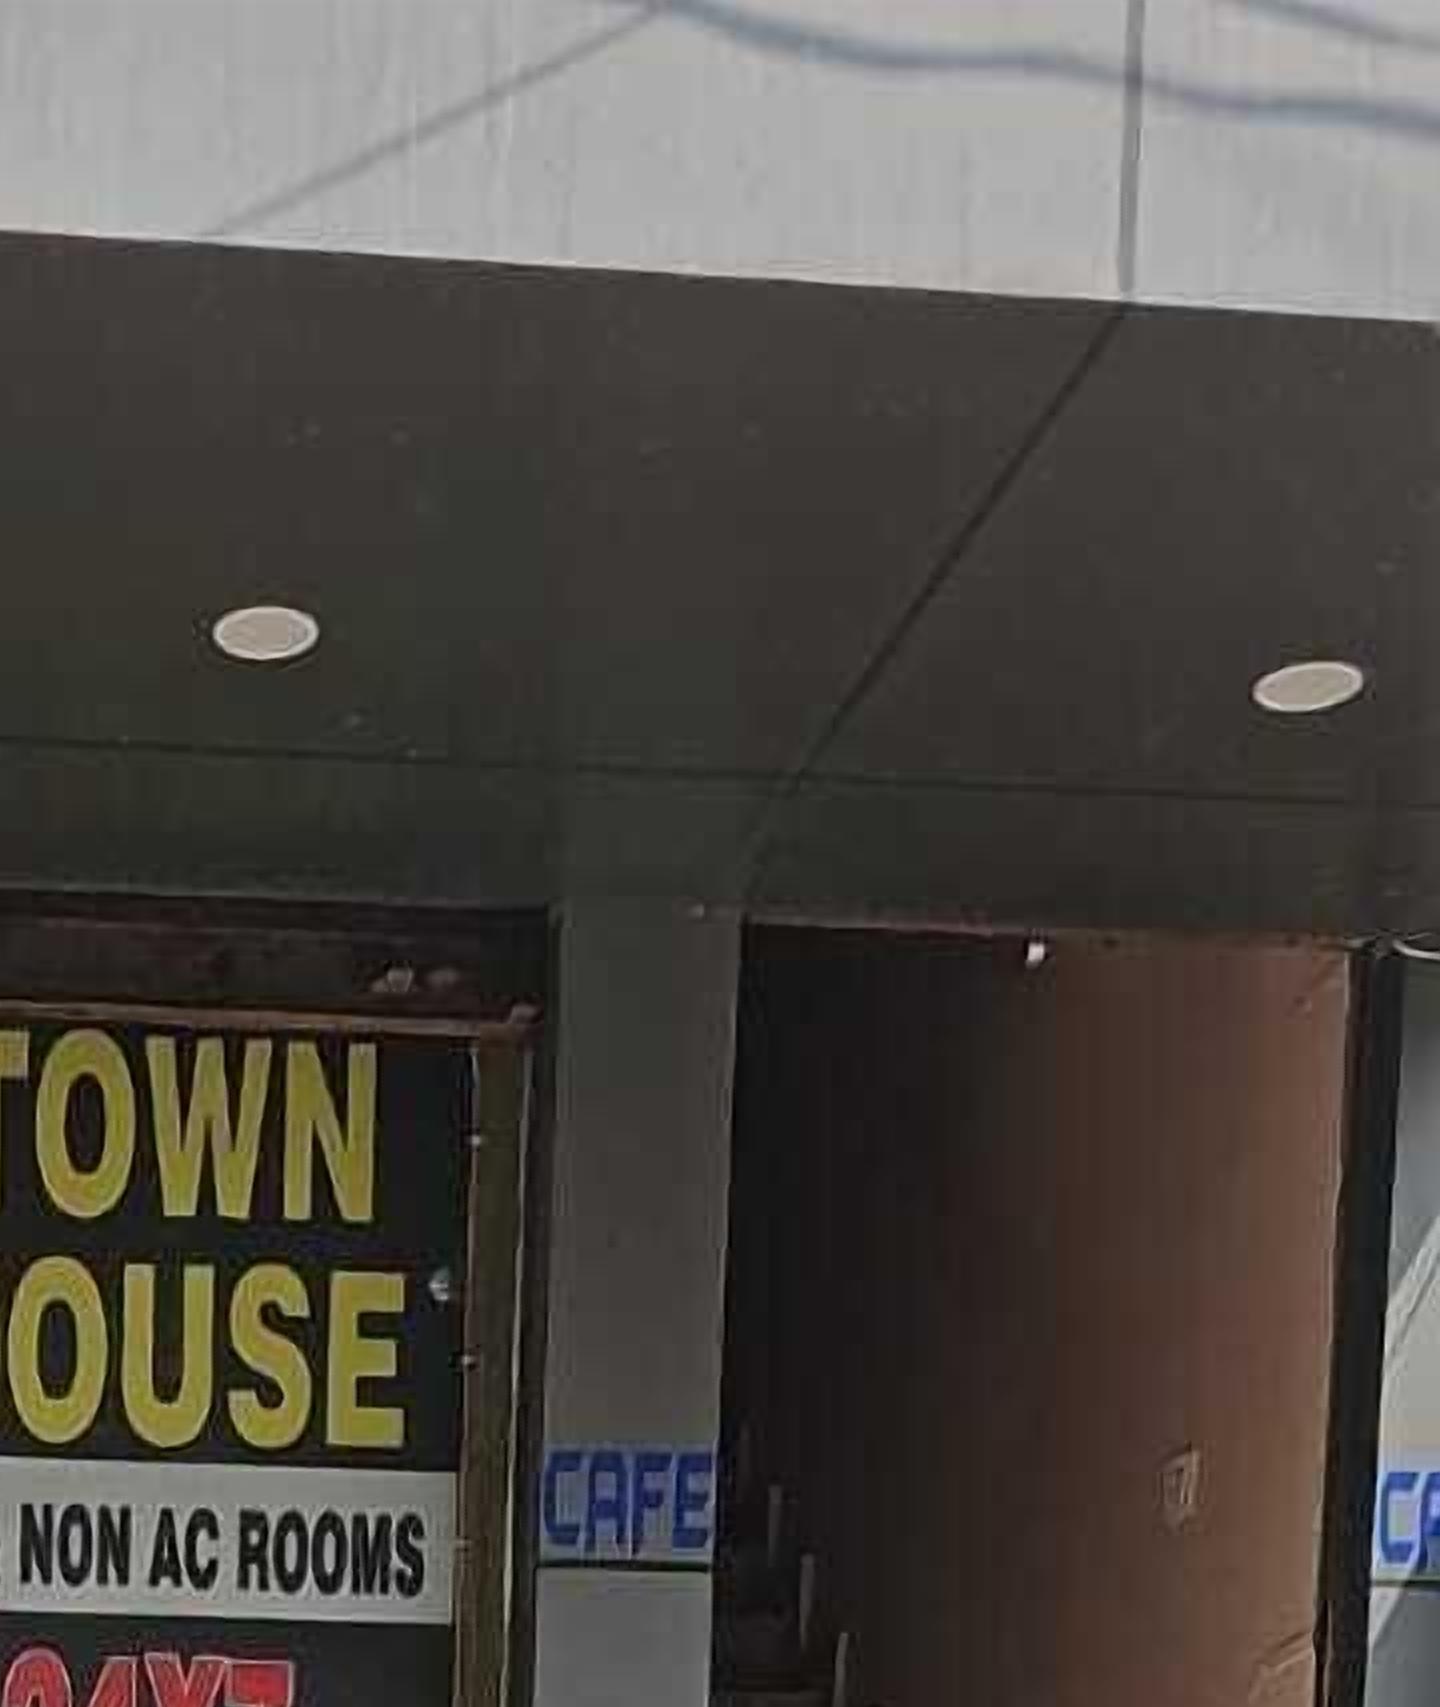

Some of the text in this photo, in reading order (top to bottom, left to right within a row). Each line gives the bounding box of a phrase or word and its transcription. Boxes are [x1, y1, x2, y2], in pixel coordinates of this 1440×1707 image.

[21, 1504, 133, 1589] NON
[150, 1509, 219, 1593] AC
[236, 1512, 427, 1599] ROOMS
[543, 1448, 714, 1555] CAFE
